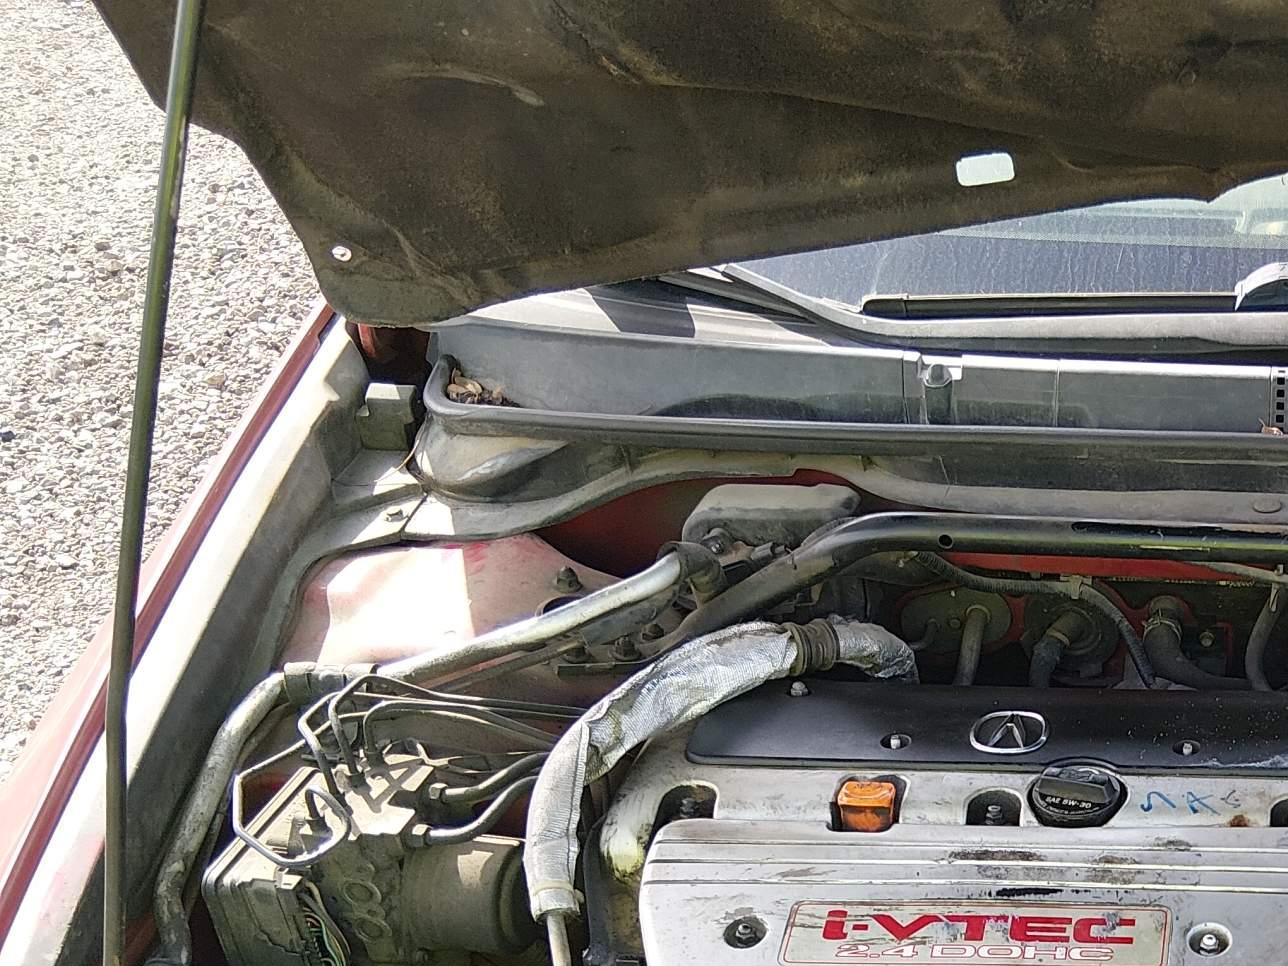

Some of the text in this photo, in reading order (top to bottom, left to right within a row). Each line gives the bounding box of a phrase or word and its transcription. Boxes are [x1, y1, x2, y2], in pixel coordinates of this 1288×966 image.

[1062, 799, 1092, 809] 5W-30
[822, 909, 1136, 945] i-VTEC
[835, 944, 1115, 961] 2.4 DOHC
